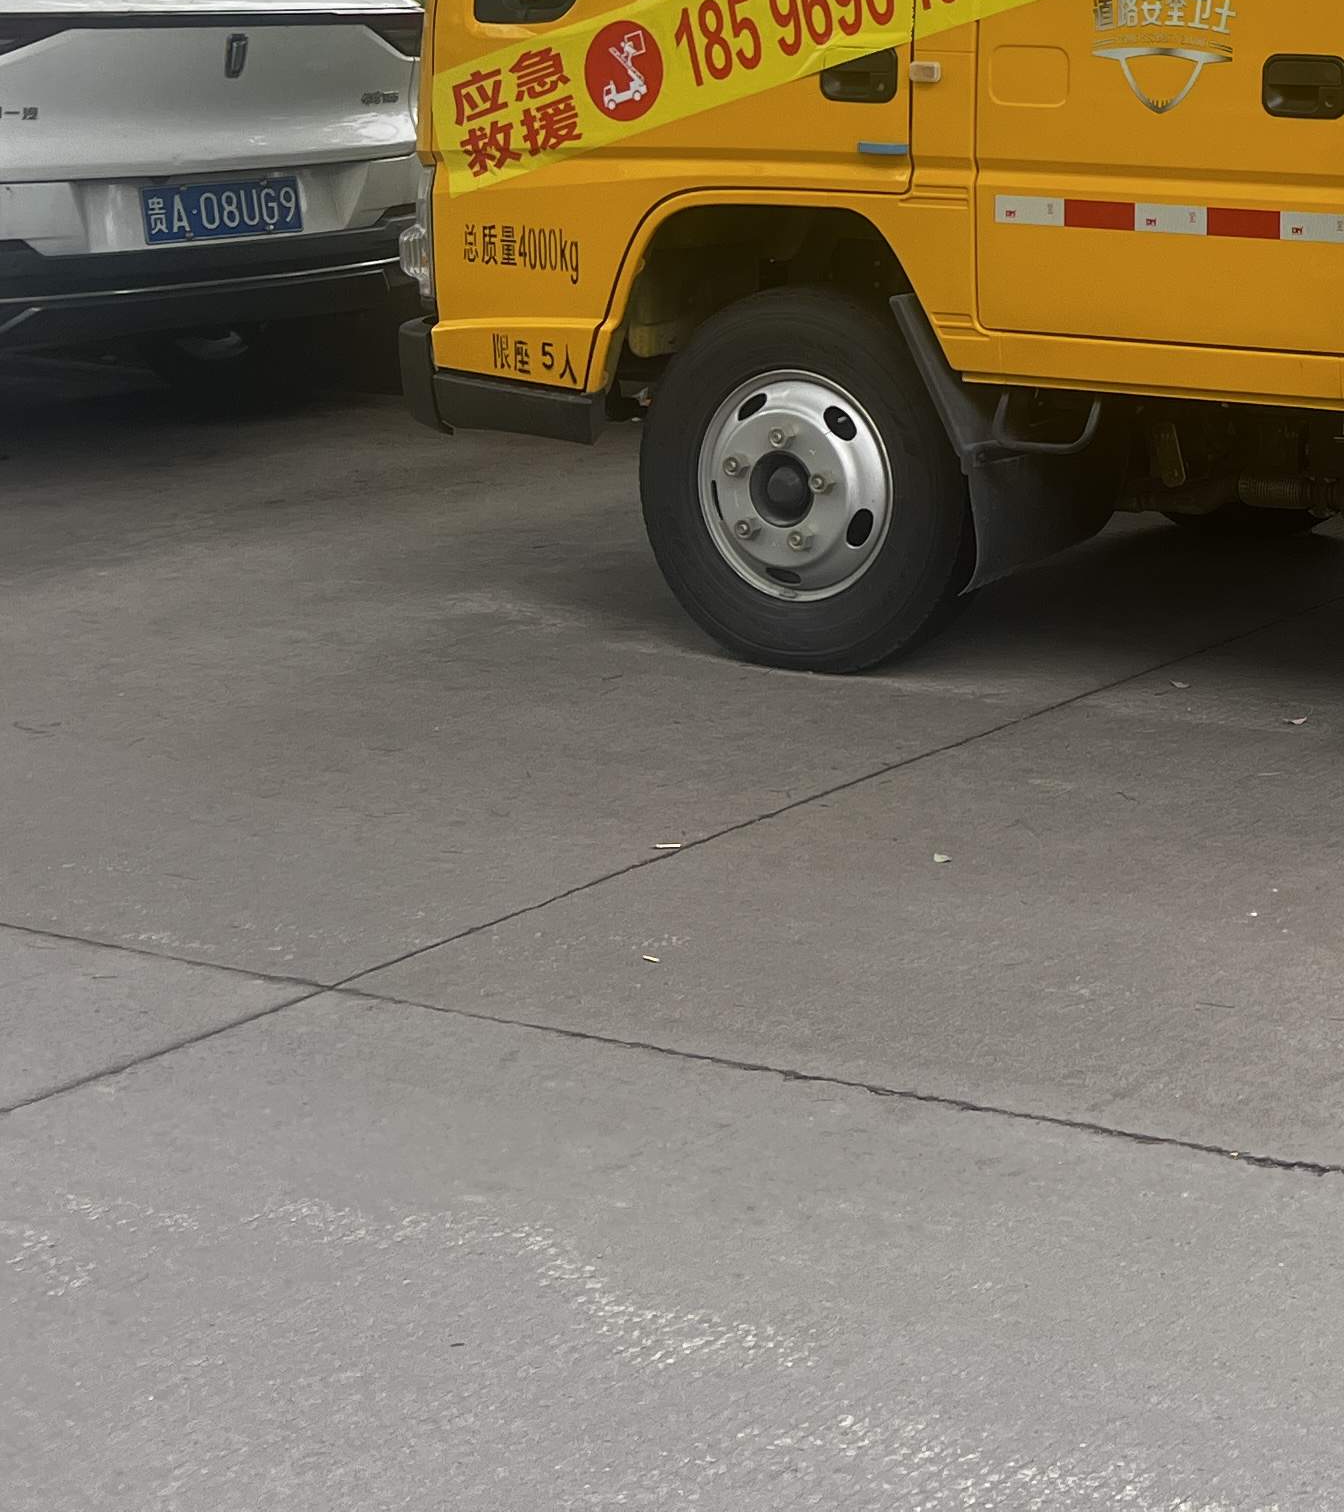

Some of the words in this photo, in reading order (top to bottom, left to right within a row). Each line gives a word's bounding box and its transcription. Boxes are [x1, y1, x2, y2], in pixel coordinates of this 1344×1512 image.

[0, 106, 39, 121] 一汽
[452, 47, 571, 126] 应急
[460, 95, 583, 177] 救援
[464, 223, 580, 285] 总质量4000kg
[492, 333, 532, 375] 限座
